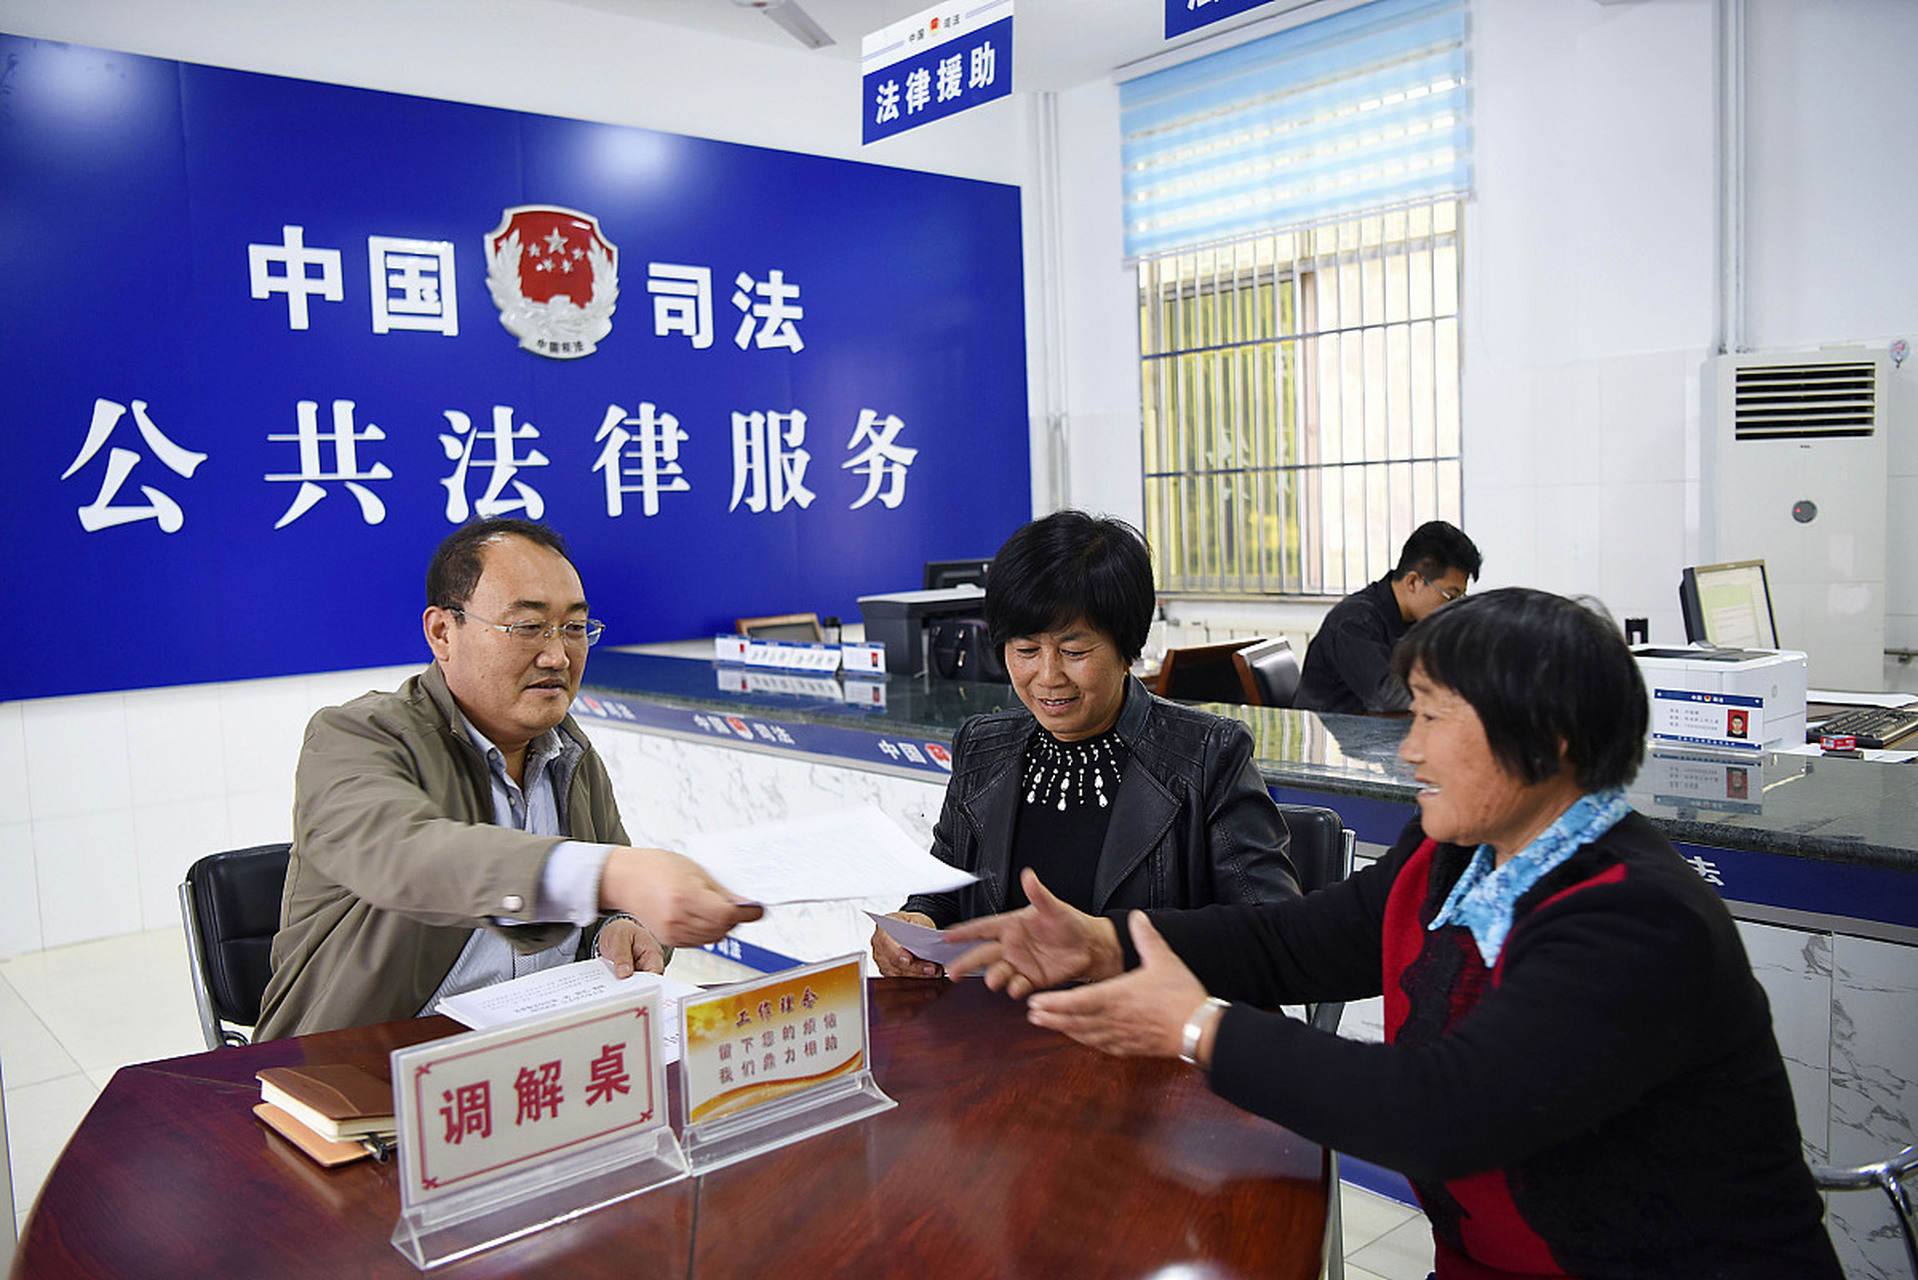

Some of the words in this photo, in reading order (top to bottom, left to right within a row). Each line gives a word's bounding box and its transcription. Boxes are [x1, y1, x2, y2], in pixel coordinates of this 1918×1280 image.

[875, 41, 996, 125] 法律援助
[248, 225, 459, 336] 中国
[647, 262, 805, 353] 司法
[61, 398, 918, 533] 公共法律服务
[878, 739, 928, 765] 中国
[439, 1042, 632, 1145] 调解桌
